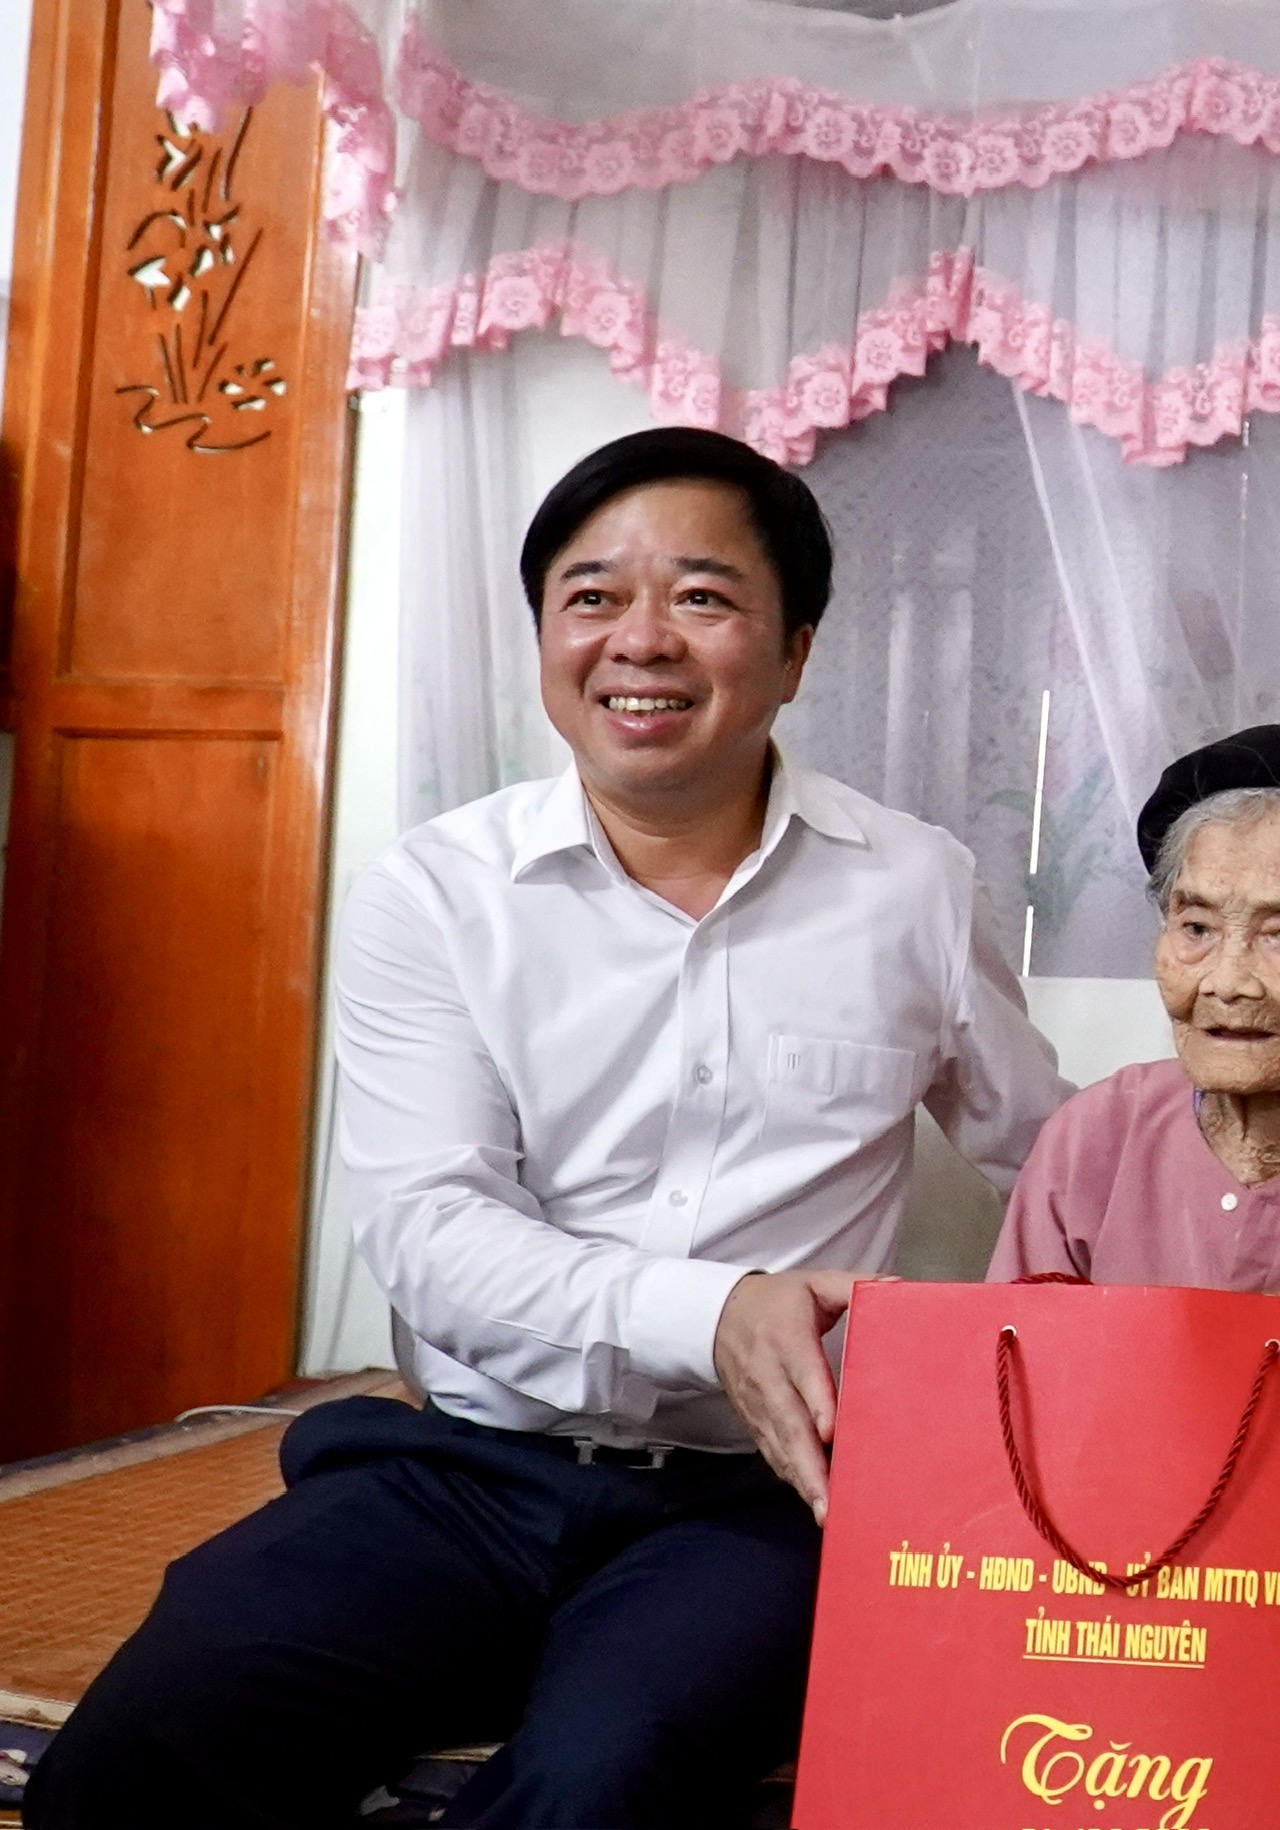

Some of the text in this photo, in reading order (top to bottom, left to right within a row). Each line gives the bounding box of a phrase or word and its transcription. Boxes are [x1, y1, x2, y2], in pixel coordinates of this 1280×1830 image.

[889, 1540, 934, 1588] TỈNH
[936, 1542, 964, 1589] ỦY
[979, 1556, 1035, 1593] HĐND
[1156, 1565, 1200, 1601] BAN
[1204, 1567, 1259, 1608] MTTQ
[1025, 1606, 1207, 1663] TỈNH THÁI NGUYÊN
[1000, 1713, 1214, 1830] Tặng
